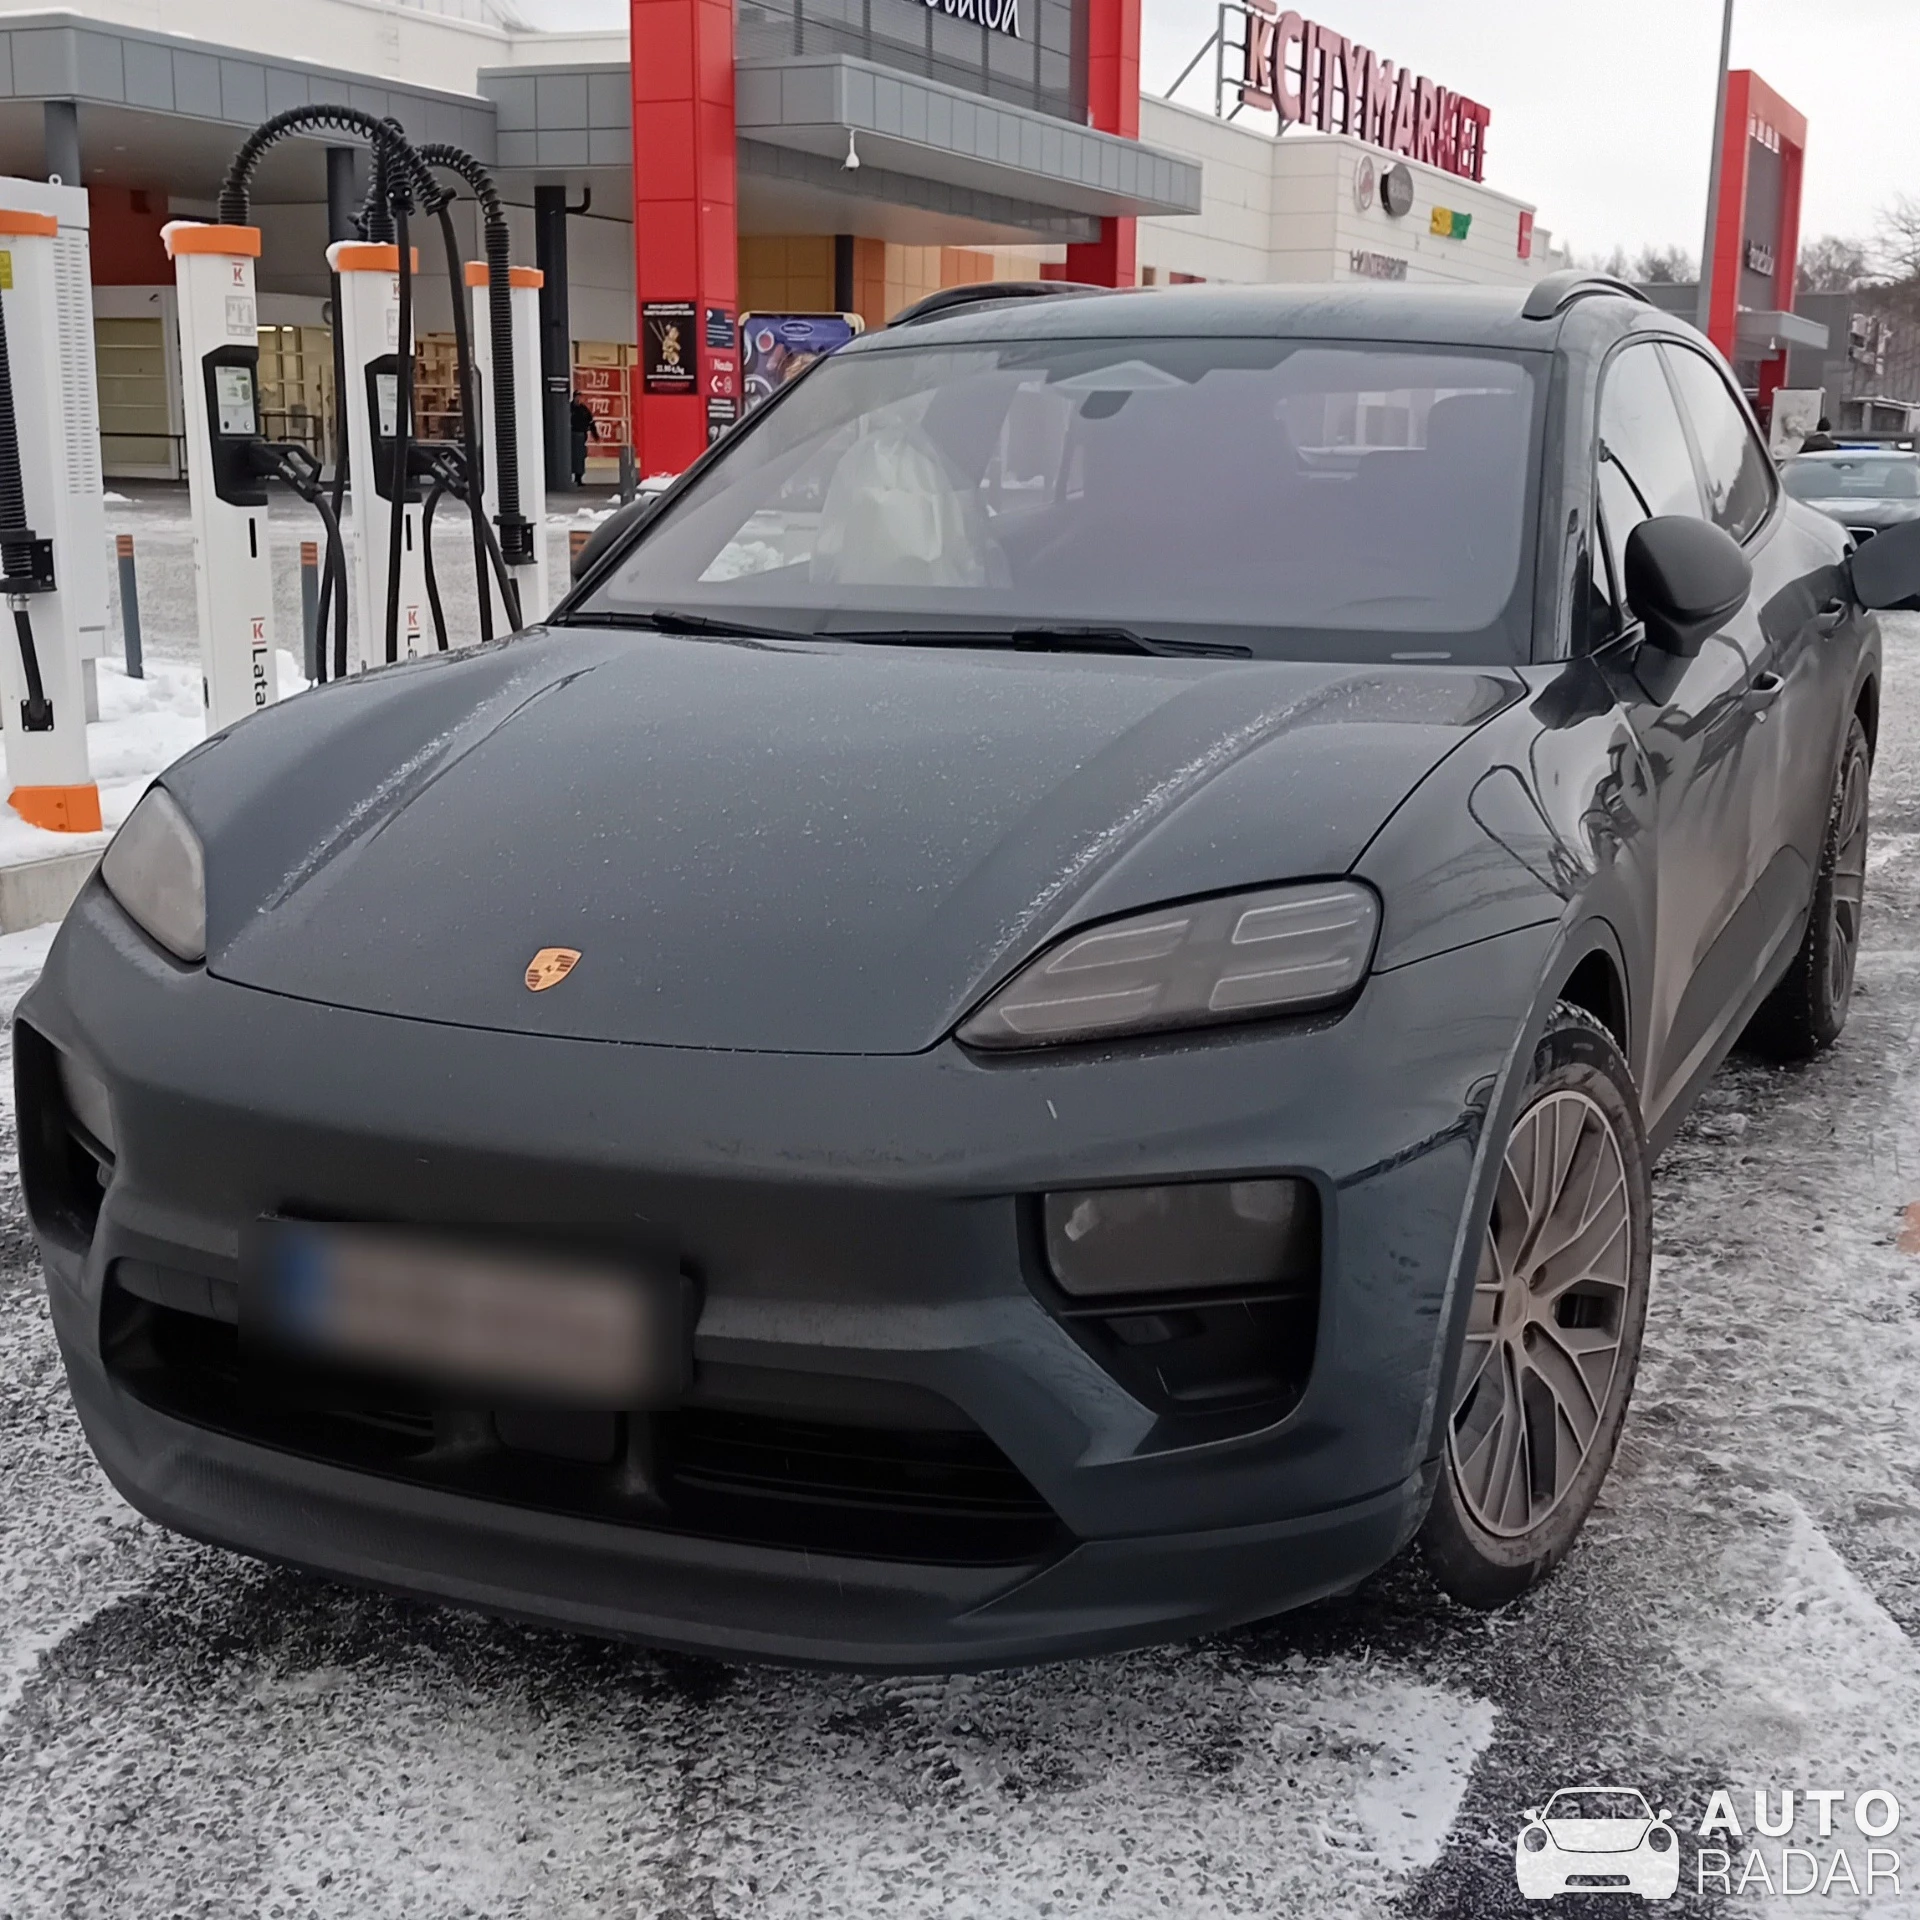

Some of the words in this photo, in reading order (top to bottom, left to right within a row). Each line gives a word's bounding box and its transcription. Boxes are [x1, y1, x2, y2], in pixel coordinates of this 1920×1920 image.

[1245, 12, 1273, 88] K
[1272, 10, 1491, 184] CITYMARKET
[408, 610, 418, 626] K
[253, 622, 264, 639] K
